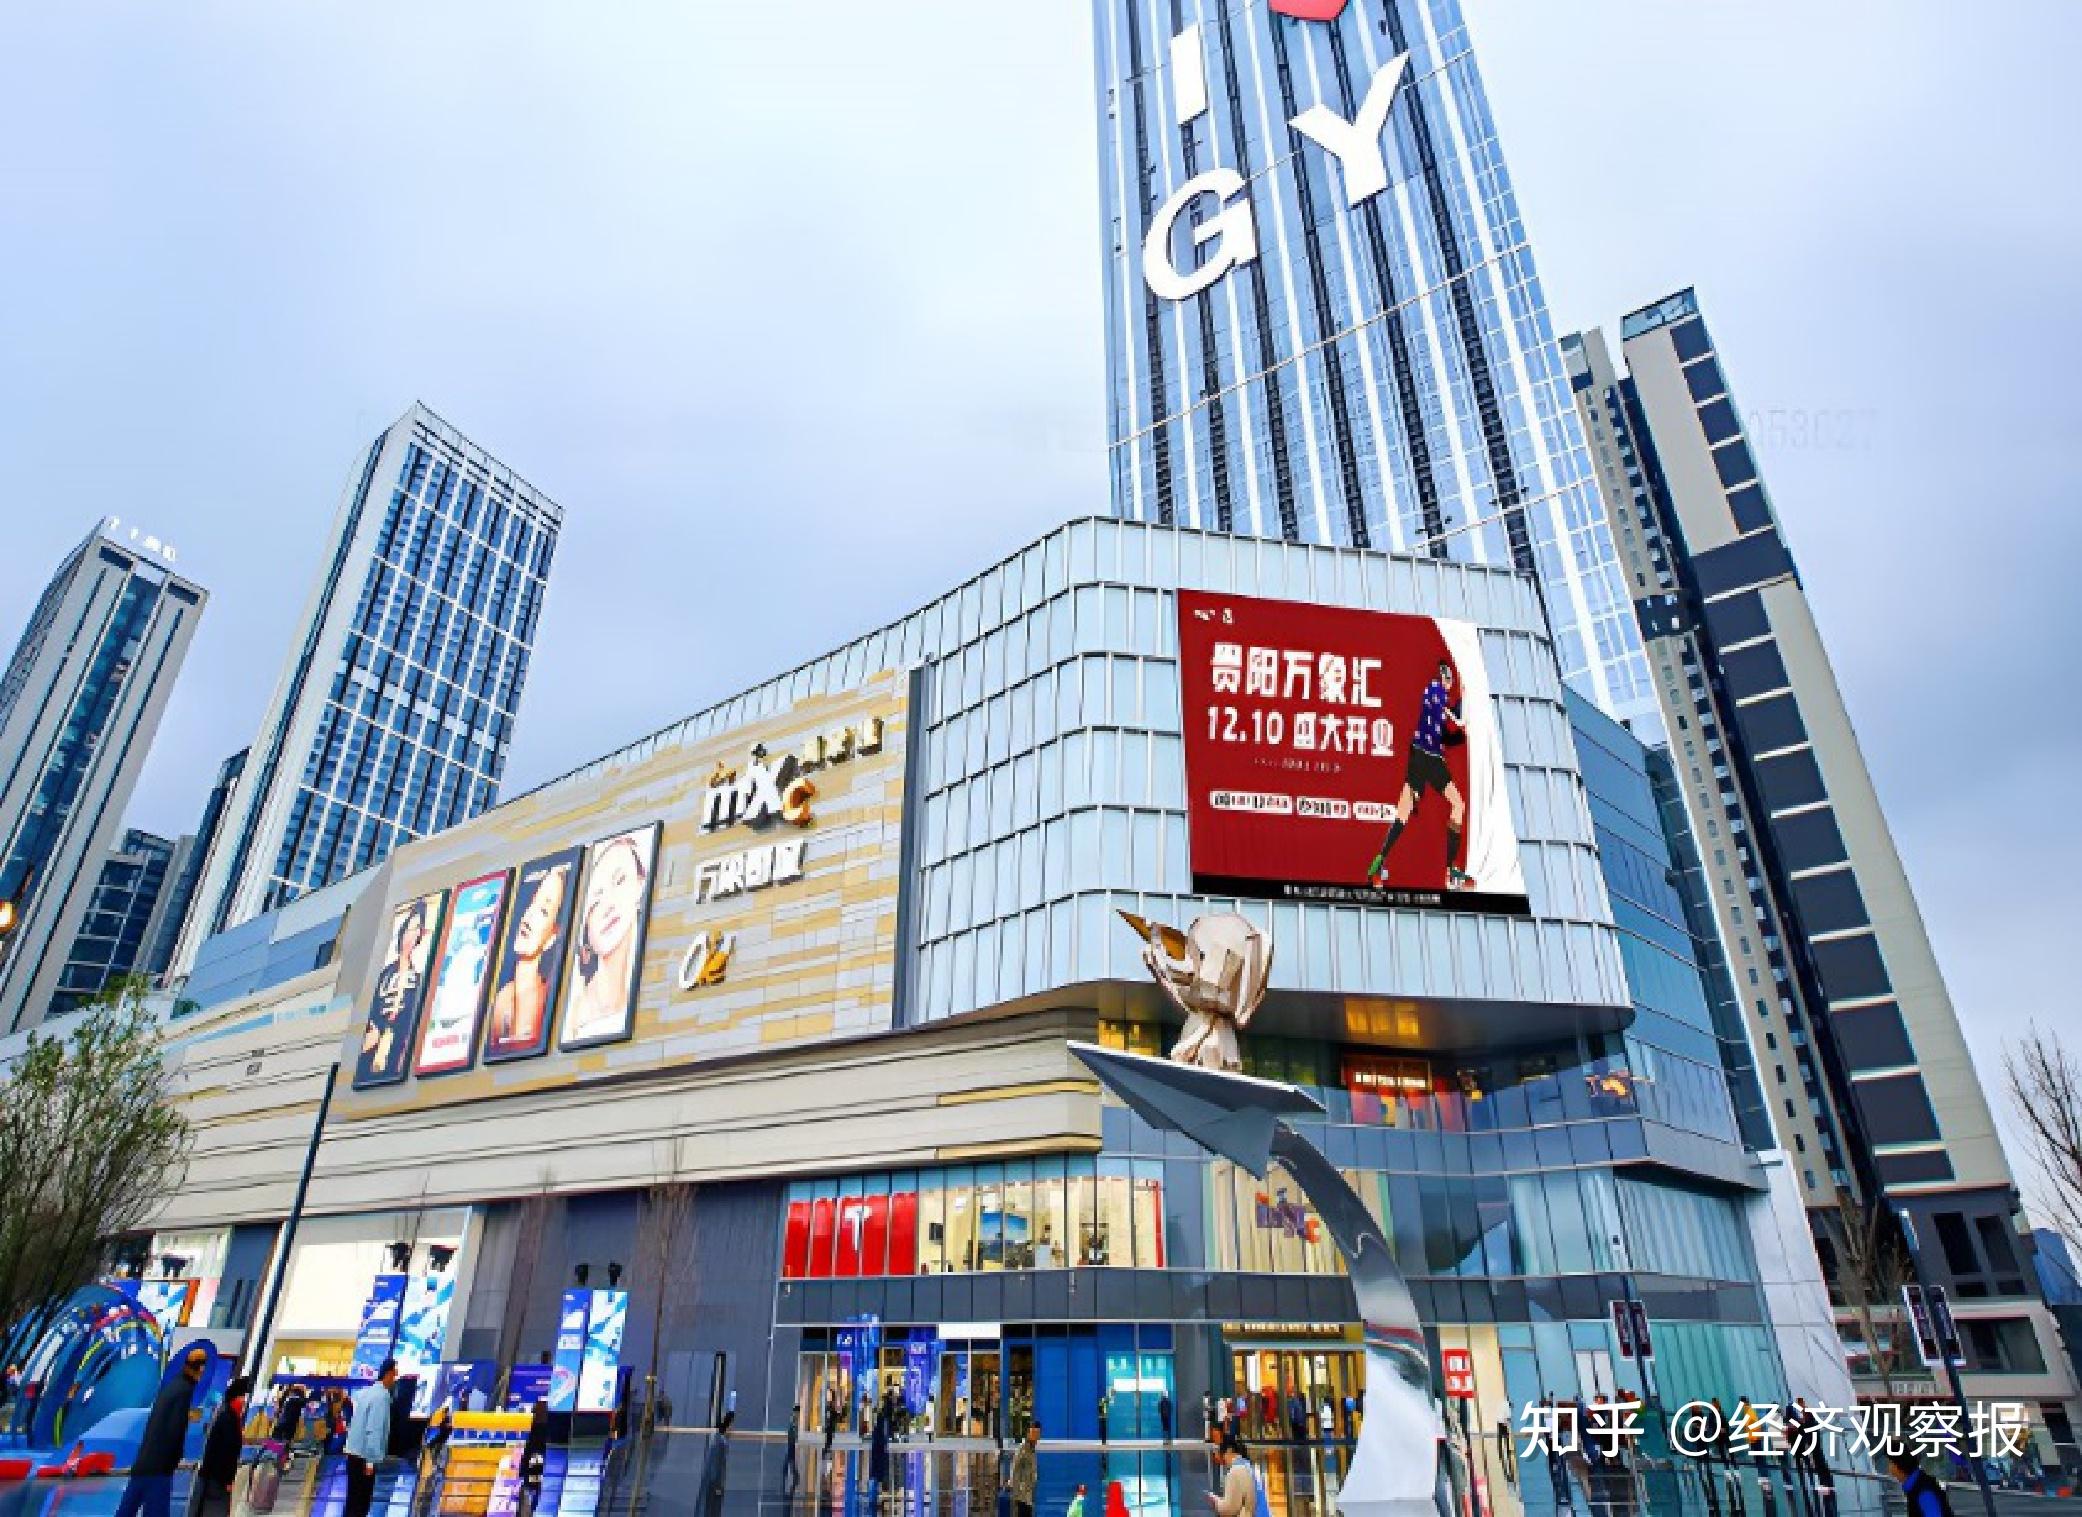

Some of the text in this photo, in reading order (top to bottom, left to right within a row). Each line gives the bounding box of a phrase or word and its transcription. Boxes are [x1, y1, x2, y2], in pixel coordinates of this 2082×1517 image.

[1210, 642, 1382, 708] 贵阳万象汇
[1207, 706, 1284, 745] 12.10
